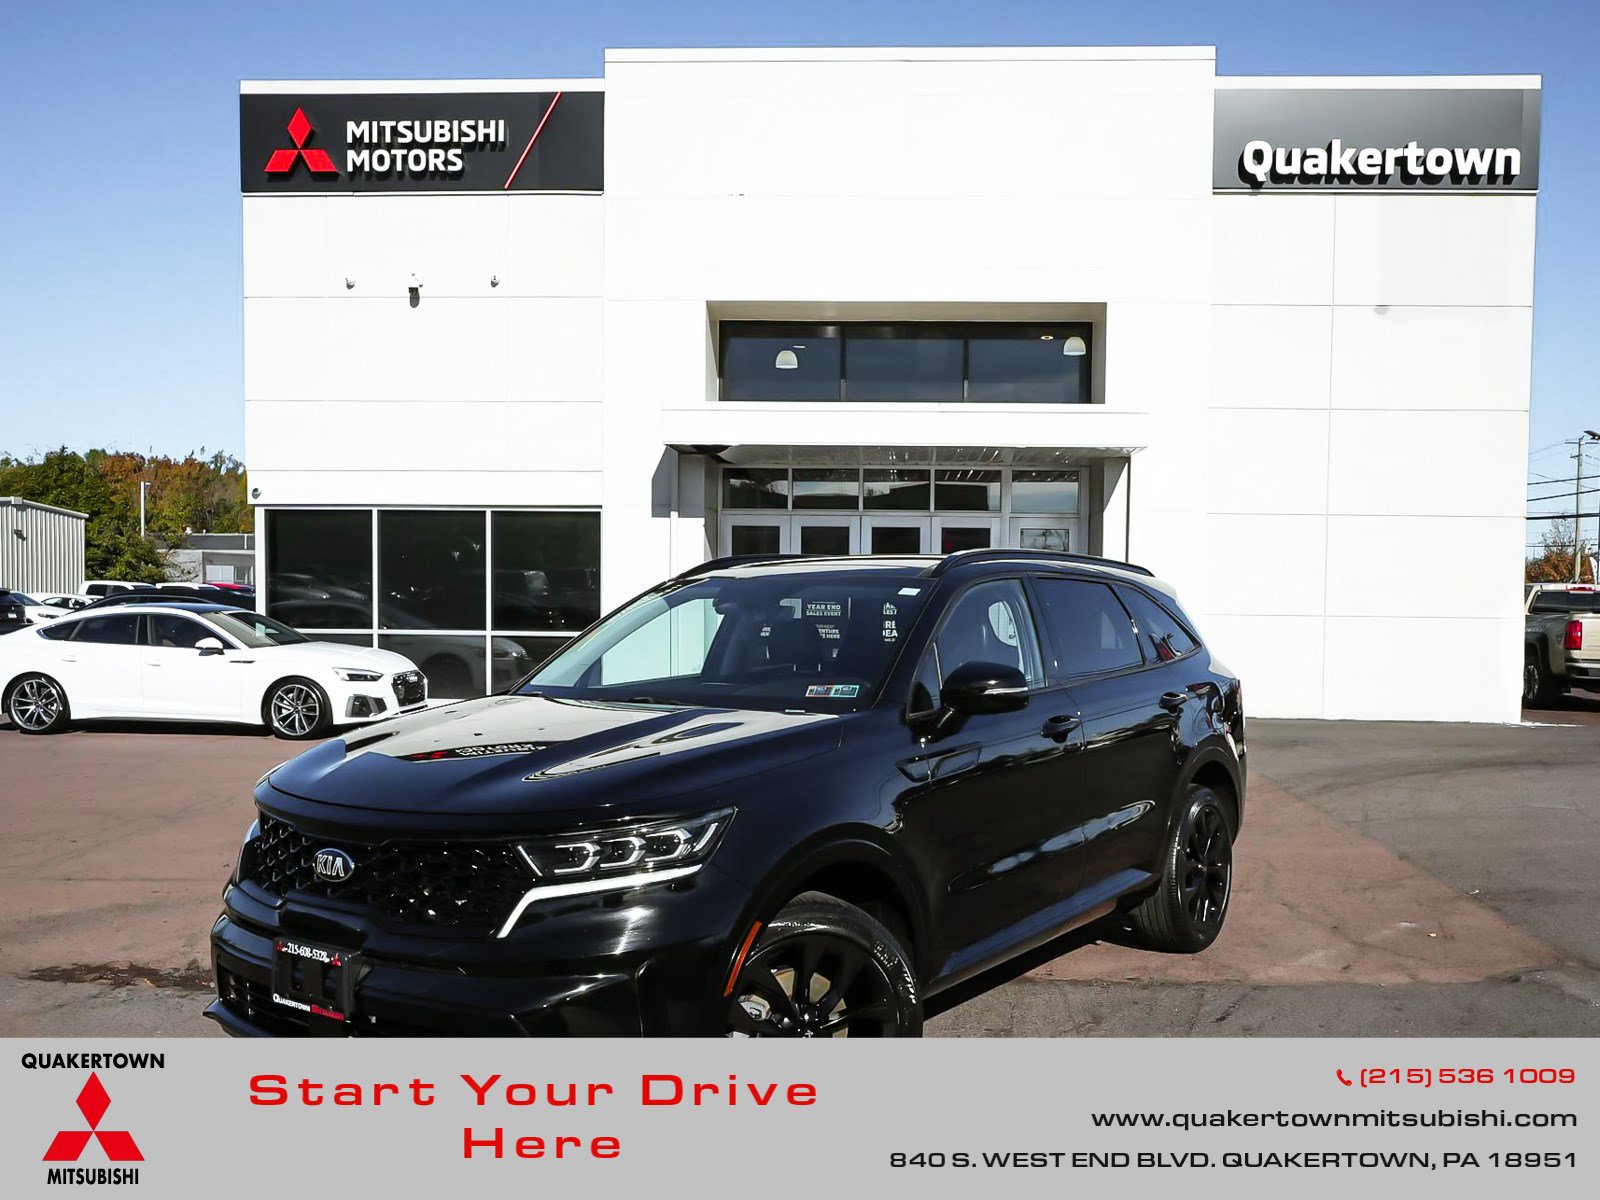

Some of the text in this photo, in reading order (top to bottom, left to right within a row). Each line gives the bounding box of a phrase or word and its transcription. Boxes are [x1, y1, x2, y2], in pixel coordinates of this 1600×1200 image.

[346, 119, 505, 144] MITSUBISHI
[346, 148, 463, 172] MOTORS
[1242, 138, 1521, 182] Quakertown
[316, 854, 345, 877] KIA
